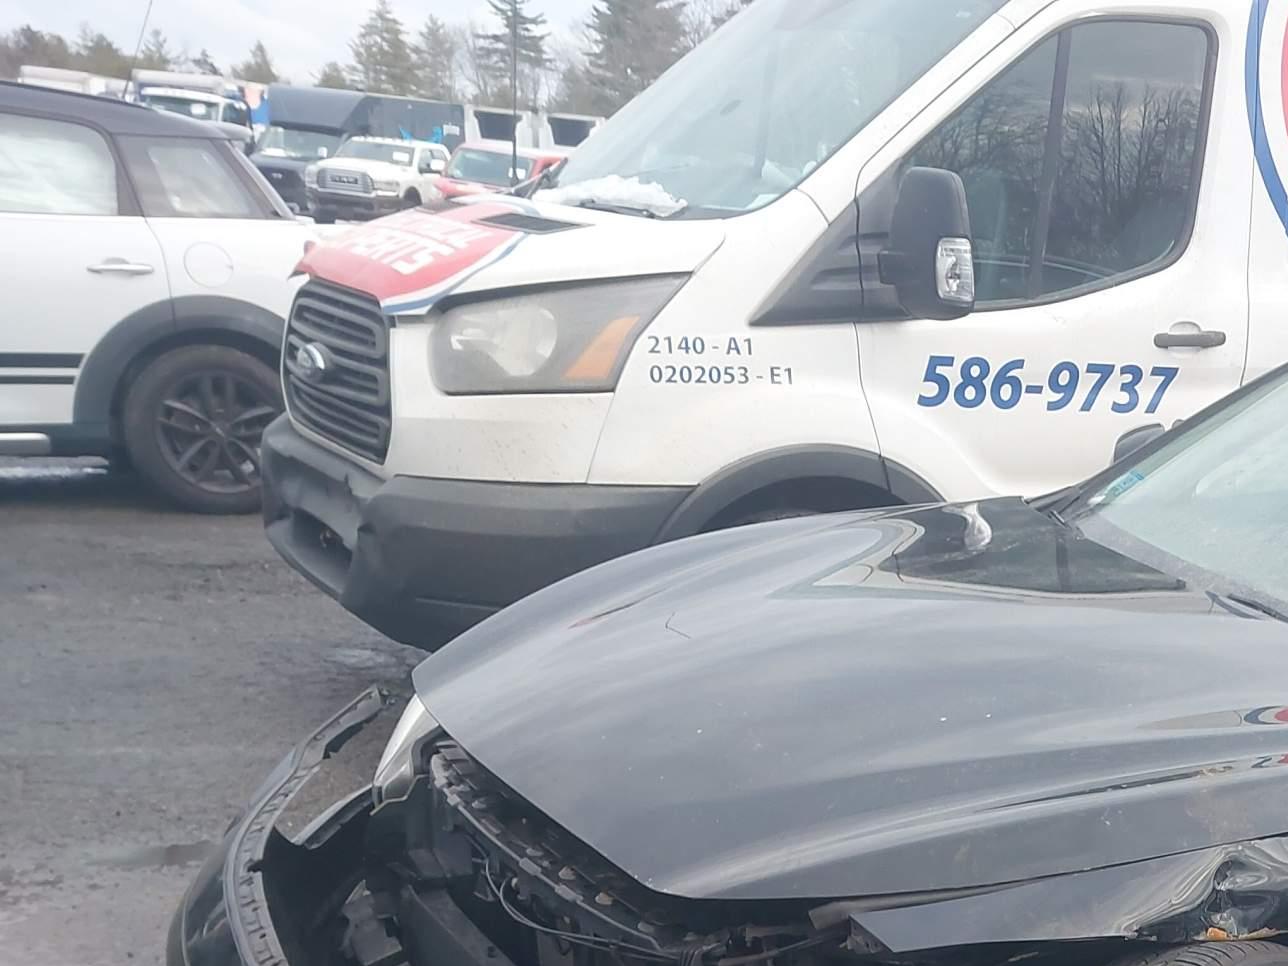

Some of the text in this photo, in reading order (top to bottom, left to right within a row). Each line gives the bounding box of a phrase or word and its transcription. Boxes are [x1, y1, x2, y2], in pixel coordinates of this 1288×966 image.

[648, 335, 705, 355] 2140
[726, 336, 753, 356] A1
[649, 364, 750, 385] 0202053
[769, 366, 793, 385] E1
[917, 354, 1180, 415] 586-9737
